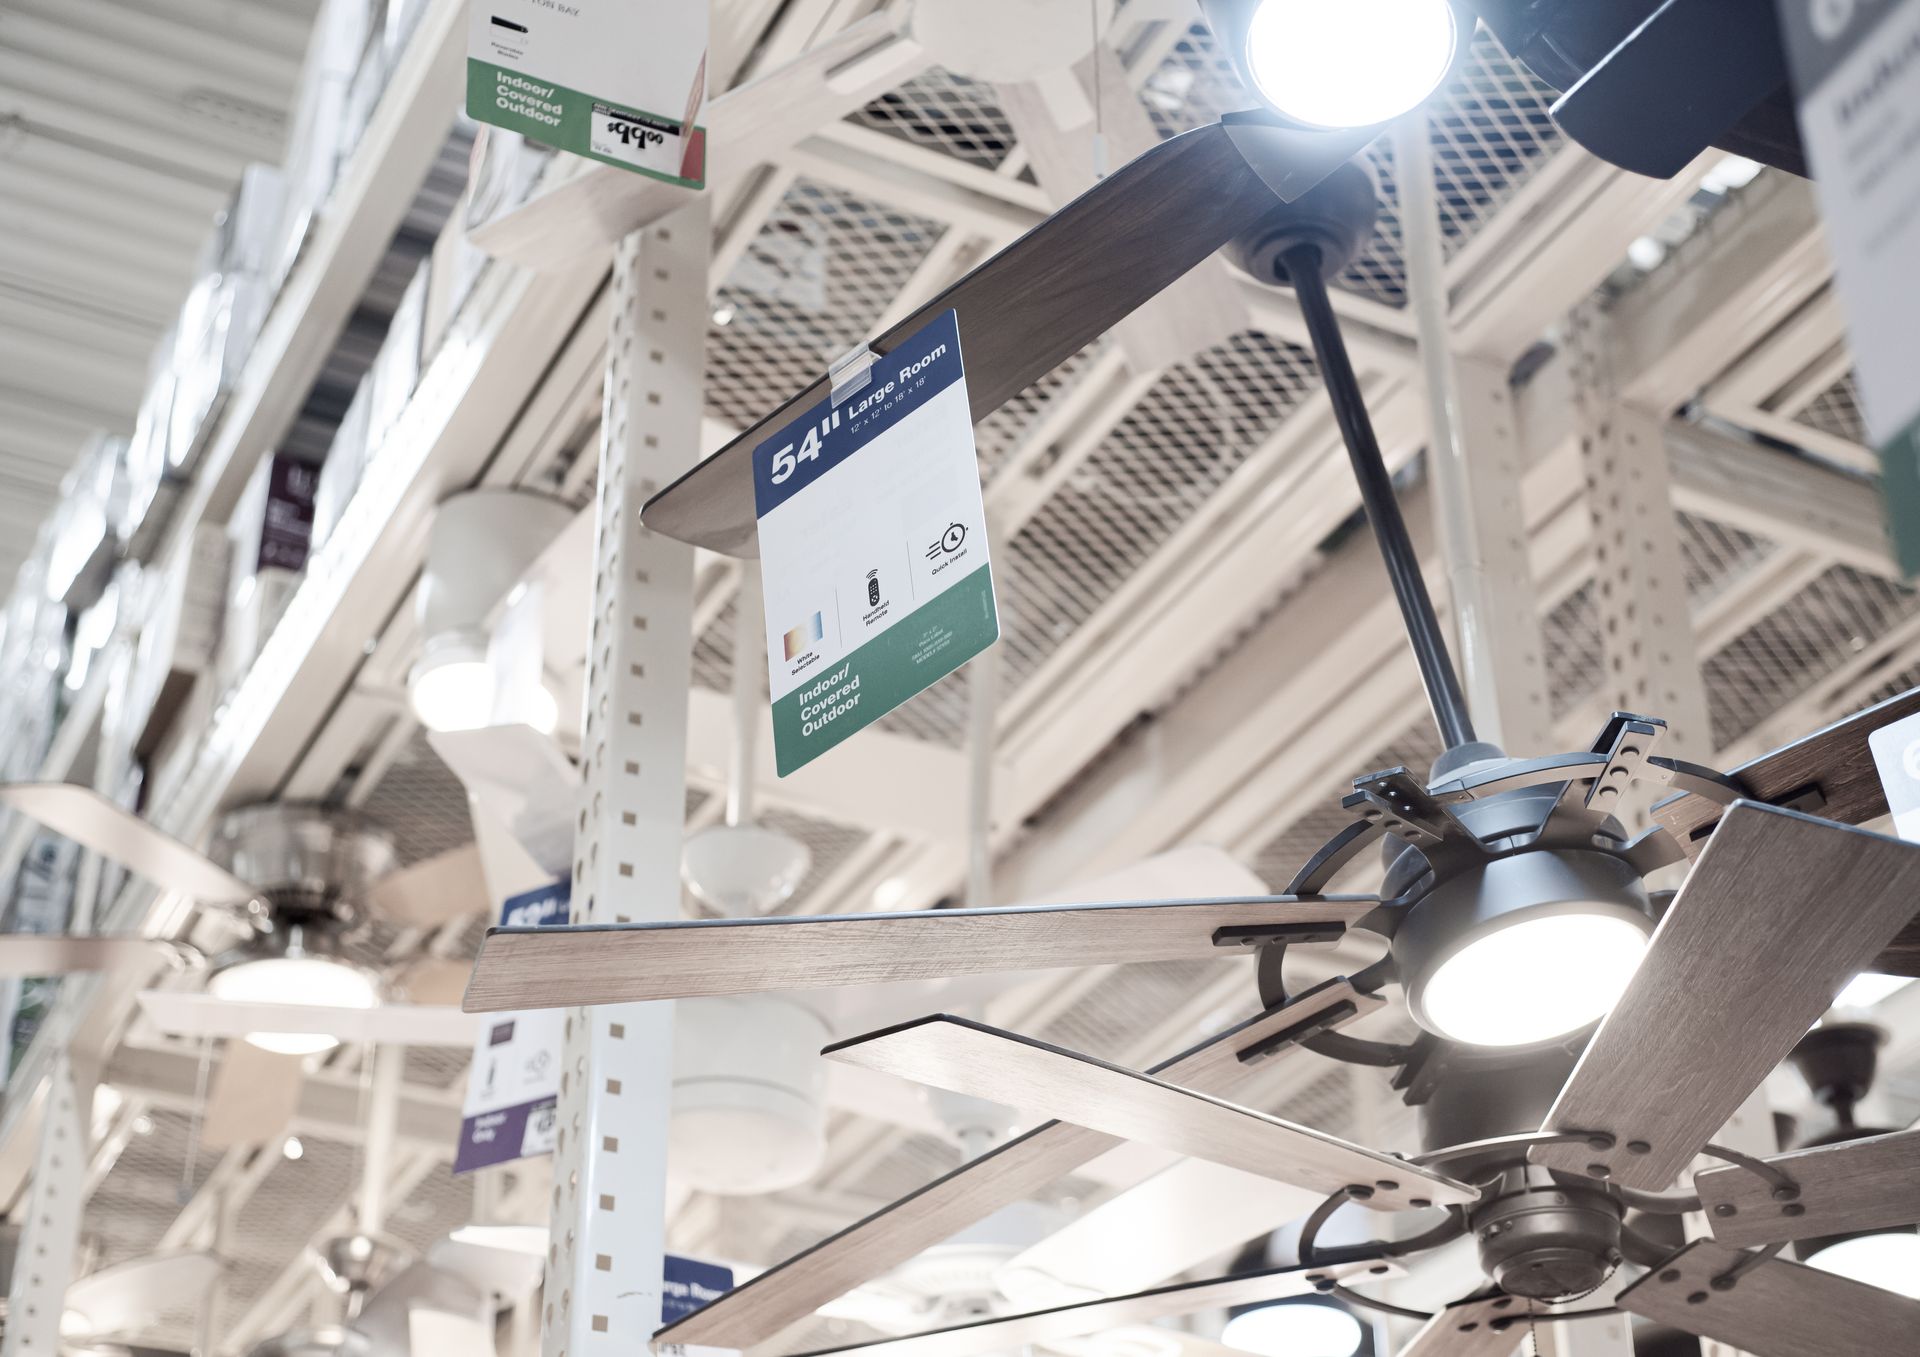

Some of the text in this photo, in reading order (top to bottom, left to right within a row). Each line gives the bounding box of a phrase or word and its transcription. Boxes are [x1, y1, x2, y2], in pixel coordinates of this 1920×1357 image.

[497, 71, 554, 98] Indoor/
[496, 84, 563, 116] Covered
[496, 96, 562, 126] Outdoor
[883, 402, 893, 411] to
[915, 375, 926, 388] 18'
[771, 343, 947, 485] 54" Large Room
[931, 548, 968, 575] Quick Install
[862, 600, 890, 621] Handheld
[865, 609, 888, 627] Remote
[791, 654, 820, 676] Selectable
[796, 651, 813, 665] White
[800, 662, 850, 706] Indoor/
[801, 674, 860, 721] Covered
[802, 693, 861, 737] Outdoor
